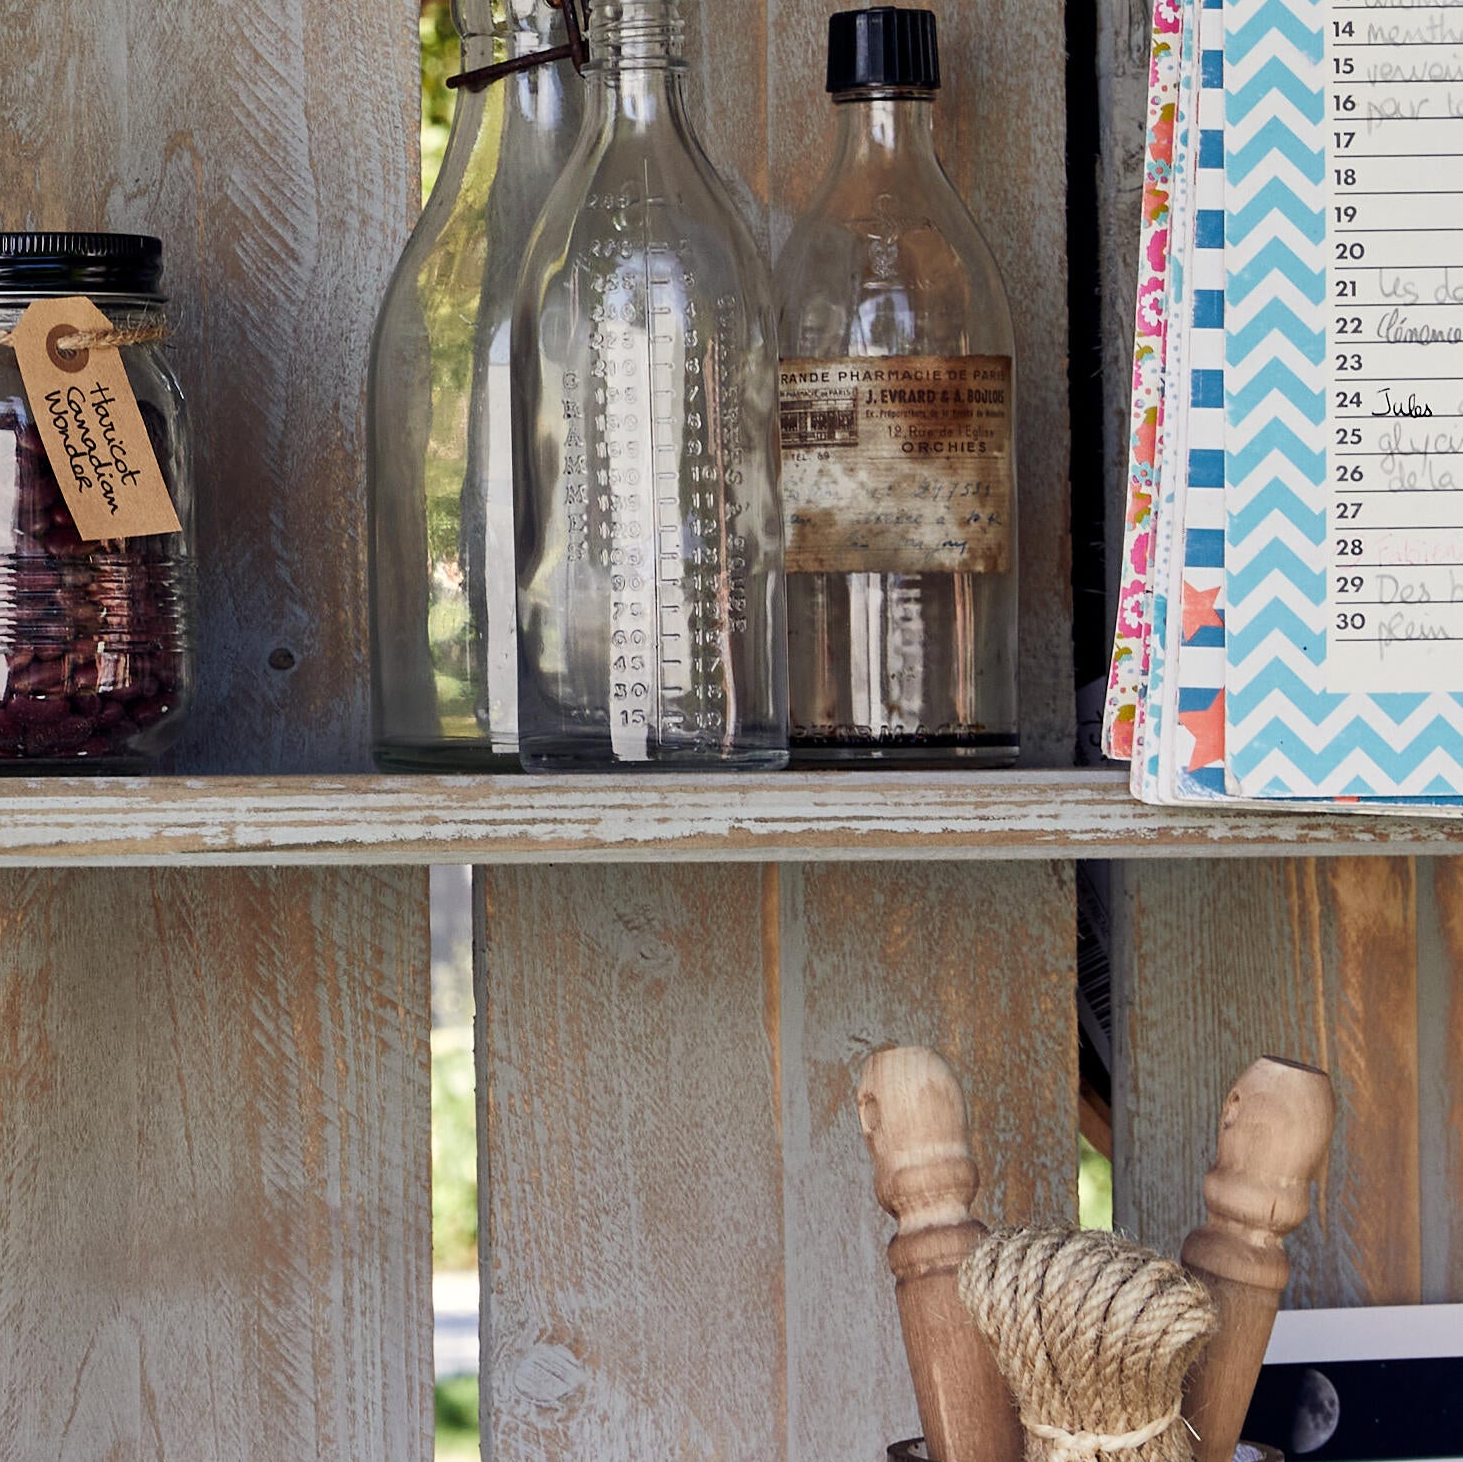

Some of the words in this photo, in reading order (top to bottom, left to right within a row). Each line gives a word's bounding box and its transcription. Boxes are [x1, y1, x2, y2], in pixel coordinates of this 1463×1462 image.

[1332, 21, 1355, 37] 14
[1333, 58, 1355, 74] 15
[1333, 95, 1356, 111] 16
[1334, 132, 1356, 148] 17
[1334, 169, 1356, 186] 18
[1334, 206, 1357, 223] 19
[1335, 243, 1365, 260] 20
[1335, 280, 1357, 297] 21
[1335, 317, 1363, 334] 22
[1335, 354, 1363, 371] 23
[780, 371, 830, 384] RANDE
[838, 370, 940, 382] PHARMACIE
[947, 370, 967, 381] DE
[881, 390, 937, 404] EVRARD
[1335, 391, 1363, 408] 24
[1371, 388, 1433, 418] Jules
[90, 382, 141, 486] Haricot
[1335, 428, 1363, 445] 25
[67, 386, 118, 515] Canadian
[902, 440, 987, 454] ORCHIES
[1335, 465, 1364, 482] 26
[1336, 502, 1363, 519] 27
[1336, 539, 1363, 556] 28
[1336, 576, 1364, 593] 29
[1336, 613, 1366, 630] 30
